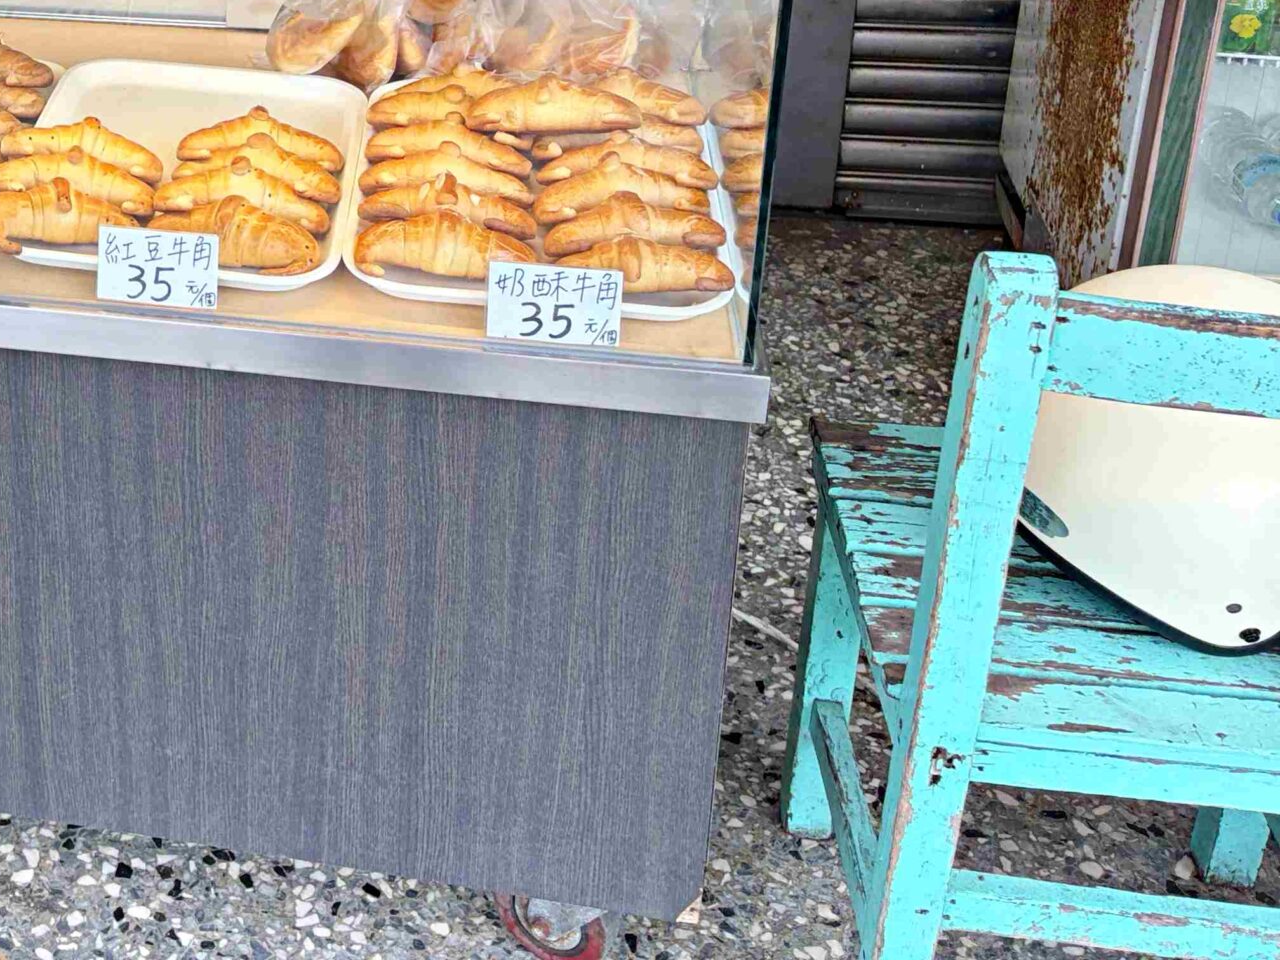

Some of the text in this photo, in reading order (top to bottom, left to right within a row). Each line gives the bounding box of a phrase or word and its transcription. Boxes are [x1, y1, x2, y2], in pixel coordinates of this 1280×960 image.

[104, 232, 212, 271] 紅豆牛角
[126, 263, 176, 302] 35
[494, 268, 619, 311] 奶酥牛角
[519, 301, 575, 339] 35
